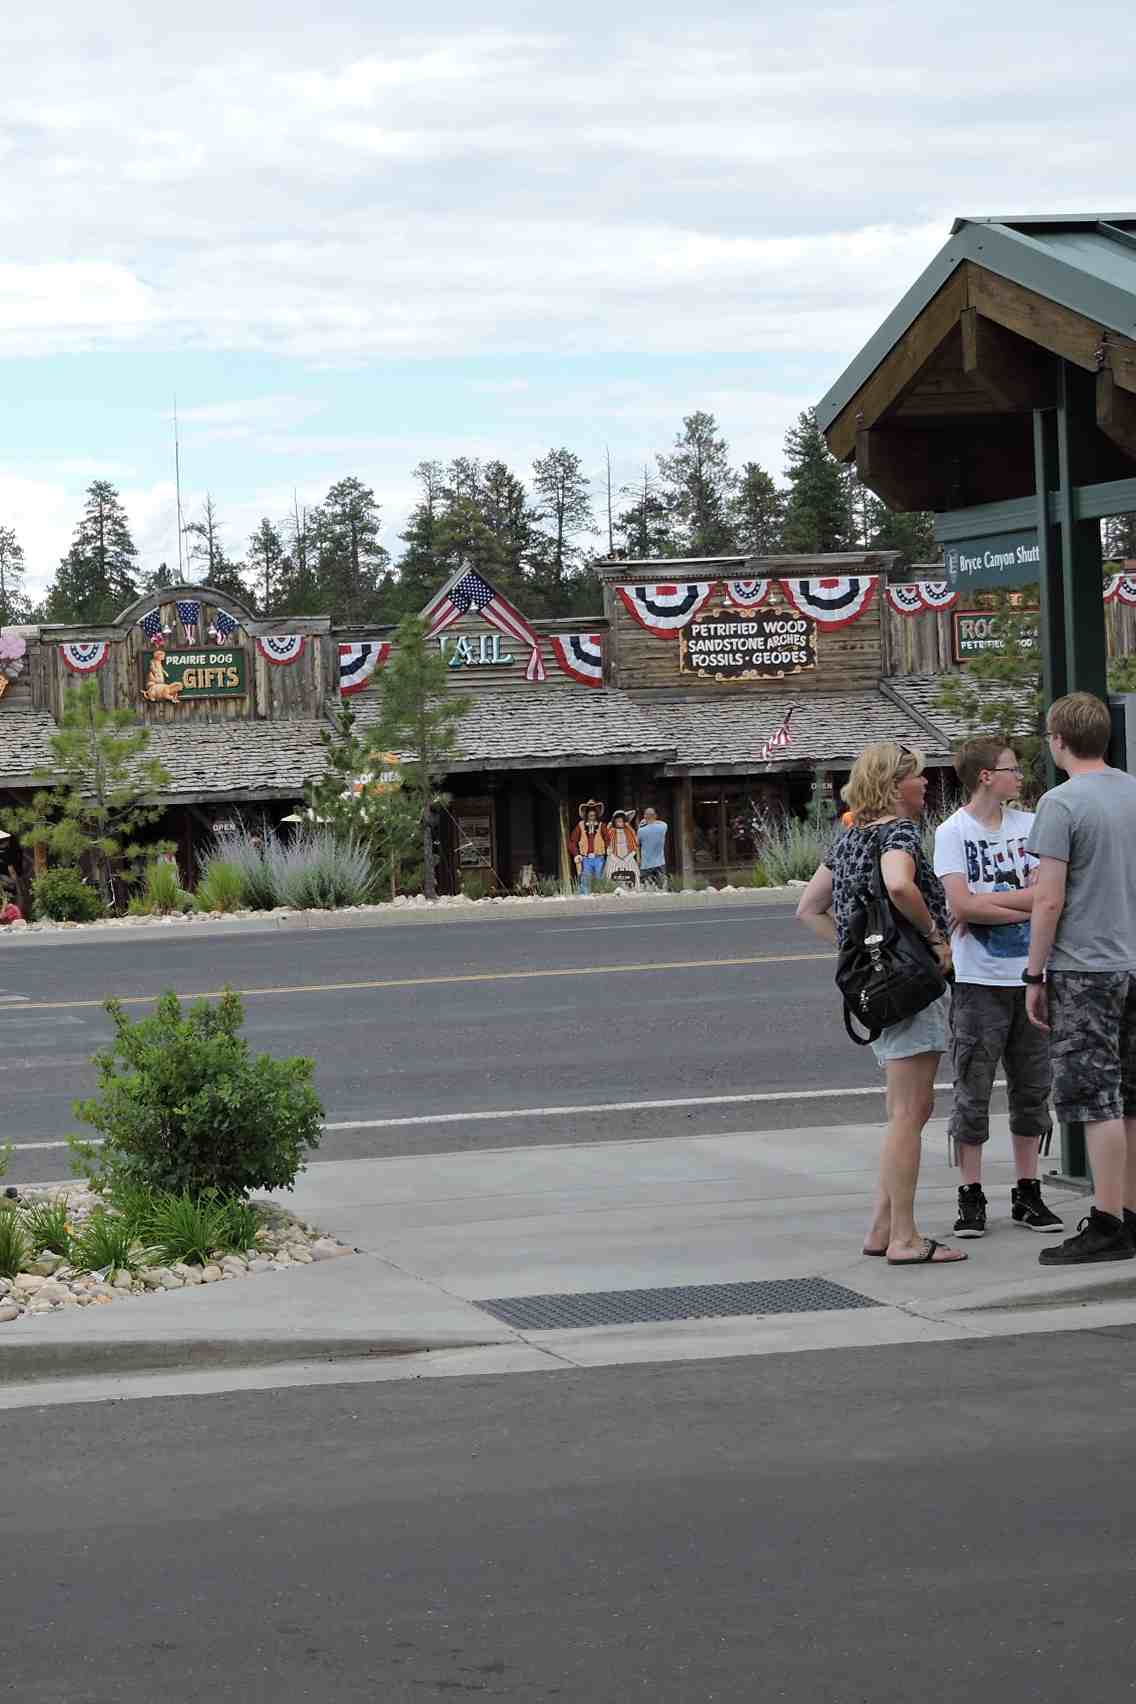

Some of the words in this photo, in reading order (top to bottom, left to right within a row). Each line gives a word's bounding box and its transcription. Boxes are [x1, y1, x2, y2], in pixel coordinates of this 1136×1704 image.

[960, 555, 982, 576] Bryce
[984, 551, 1015, 572] Canyon
[691, 622, 758, 637] PETRIFIED
[763, 620, 808, 634] WOOD
[688, 637, 765, 653] SANDSTONE
[767, 633, 807, 650] ARCHES
[166, 655, 206, 665] PRAIRIE
[209, 653, 233, 664] DOG
[691, 653, 744, 667] FOSSILS
[752, 650, 807, 664] GEODES
[183, 667, 240, 689] GIFTS
